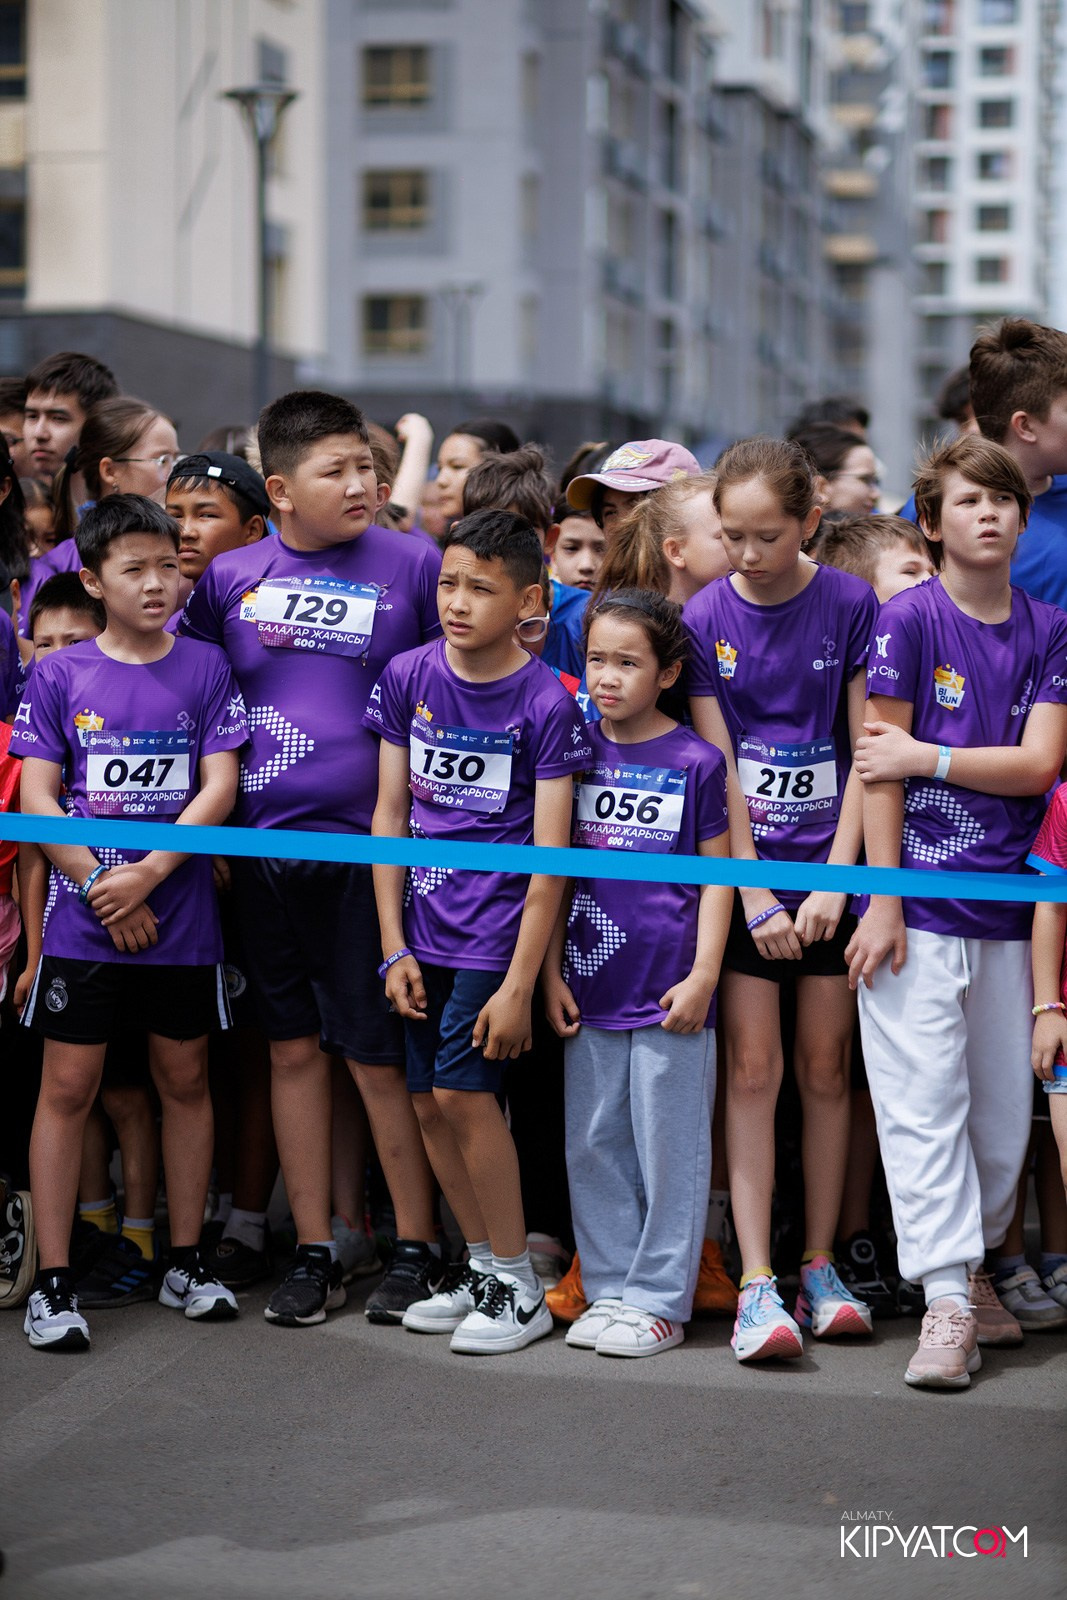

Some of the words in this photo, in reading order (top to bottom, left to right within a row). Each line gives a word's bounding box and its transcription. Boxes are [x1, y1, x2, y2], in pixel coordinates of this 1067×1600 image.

[282, 593, 348, 626] 129
[257, 622, 309, 637] БАЛАЛАР
[311, 629, 365, 645] ЖАРЫСЫ
[293, 638, 316, 648] 600
[879, 666, 900, 680] City
[938, 687, 948, 696] BI
[940, 695, 958, 705] RUN
[216, 719, 247, 736] Dream
[104, 758, 175, 788] 047
[422, 748, 485, 782] 130
[410, 771, 447, 794] БАЛАЛАР
[448, 785, 503, 801] ЖАРЫСЫ
[756, 767, 815, 799] 218
[88, 792, 138, 802] БАЛАЛАР
[139, 791, 187, 802] ЖАРЫСЫ
[432, 793, 454, 805] 600
[122, 803, 146, 813] 600
[594, 790, 664, 825] 056
[746, 797, 782, 812] ЛАЛАР
[782, 798, 833, 813] ЖАРЫСЫ
[766, 812, 789, 823] 600
[579, 821, 621, 836] БАЛАЛАР
[620, 826, 675, 842] ЖАРЫСЫ
[607, 836, 624, 847] 600
